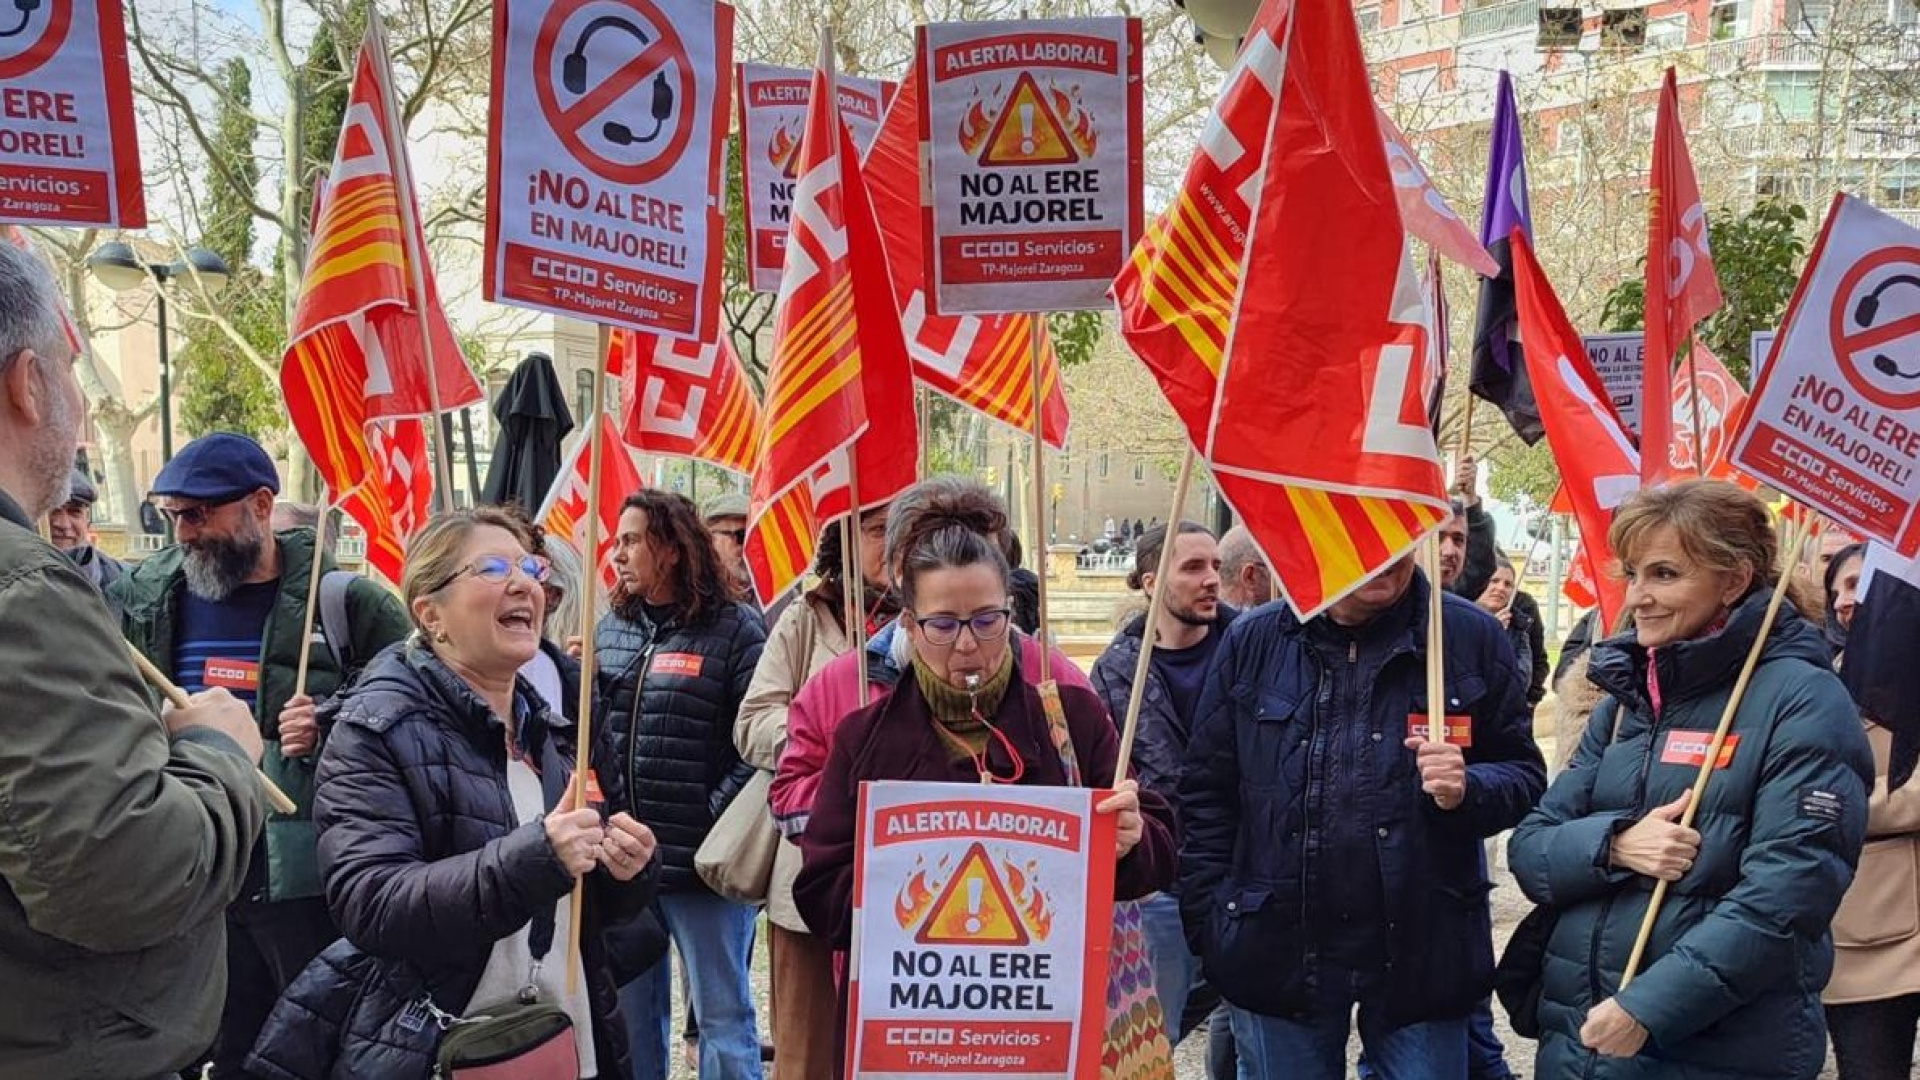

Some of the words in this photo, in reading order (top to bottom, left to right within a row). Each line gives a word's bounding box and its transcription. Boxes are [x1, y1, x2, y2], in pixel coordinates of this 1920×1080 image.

[945, 45, 1021, 71] ALERTA
[1022, 42, 1107, 64] LABORAL
[3, 88, 77, 123] ERE
[0, 129, 84, 158] OREL!
[0, 174, 80, 195] ervicios
[960, 173, 1003, 197] NO
[1010, 174, 1038, 195] AL
[1045, 169, 1099, 193] ERE
[3, 198, 61, 213] Zaragoza
[528, 169, 590, 210] ¡NO
[595, 191, 627, 219] AL
[632, 193, 684, 234] ERE
[960, 198, 1103, 225] MAJOREL
[531, 211, 563, 240] EN
[571, 220, 687, 270] MAJOREL!
[961, 242, 1019, 258] CCOO
[1024, 240, 1095, 257] Servicios
[531, 256, 598, 287] CCOO
[604, 273, 676, 304] Servicios
[981, 262, 1037, 276] TP-Majorel
[1039, 262, 1084, 276] Zaragoza
[554, 286, 616, 312] TP-Majorel
[617, 301, 658, 320] Zaragoza
[1613, 346, 1631, 362] AL
[1791, 374, 1844, 413] ¡NO
[1844, 404, 1869, 432] AL
[1873, 415, 1920, 459] ERE
[1782, 404, 1814, 432] EN
[1814, 421, 1912, 487] MAJOREL!
[1771, 438, 1826, 477] CCOO
[1826, 468, 1890, 513] Servicios
[1781, 466, 1832, 500] TP-Majorel
[1830, 492, 1866, 520] Zaragoza
[208, 667, 245, 681] CCOO
[1412, 724, 1450, 737] CCO
[887, 811, 971, 836] ALERTA
[974, 811, 1069, 842] LABORAL
[892, 950, 942, 978] NO
[949, 955, 982, 977] AL
[989, 953, 1051, 979] ERE
[890, 983, 1053, 1010] MAJOREL
[886, 1028, 954, 1045] CCOO
[960, 1029, 1040, 1046] Servicios
[908, 1051, 972, 1067] TP-Majorel
[973, 1052, 1025, 1067] Zaragoza
